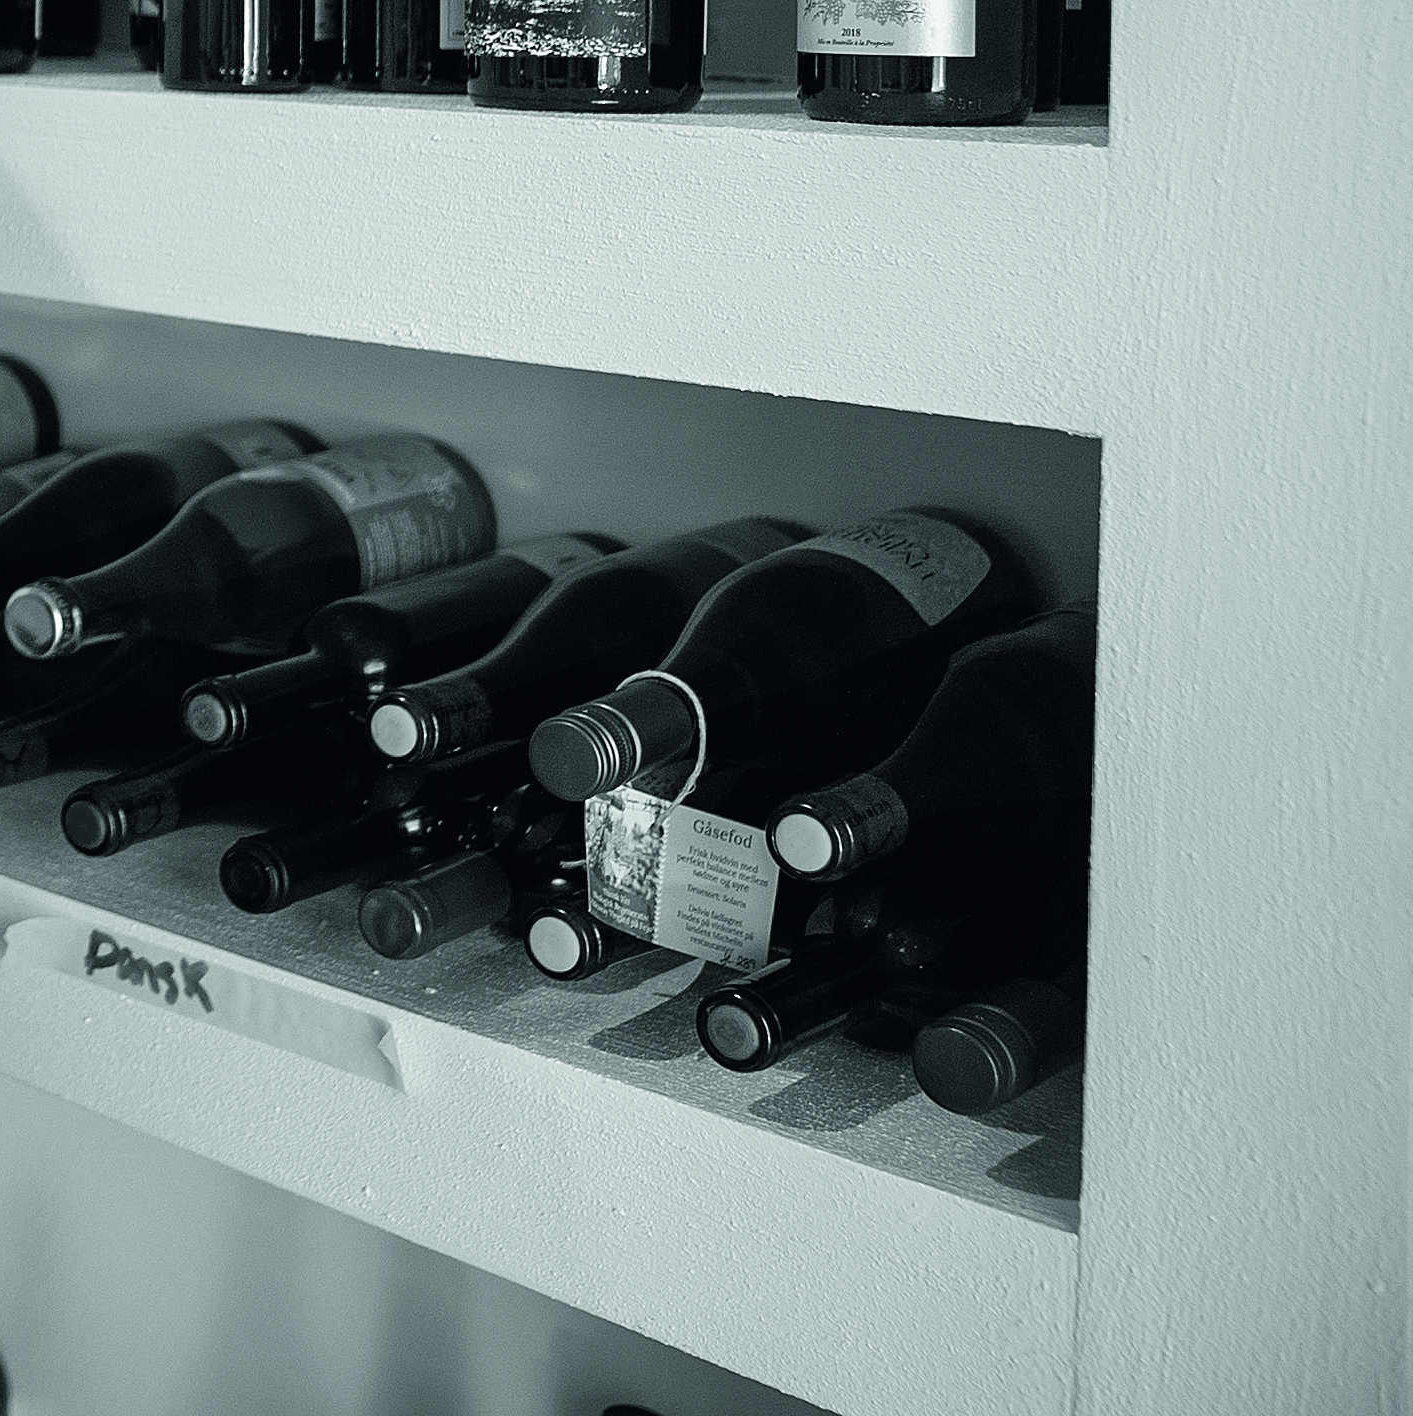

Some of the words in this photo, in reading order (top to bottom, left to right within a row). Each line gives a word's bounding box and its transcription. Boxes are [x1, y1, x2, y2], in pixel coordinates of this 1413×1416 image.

[841, 28, 861, 37] 2018
[693, 819, 753, 849] Gåsefod
[740, 864, 759, 874] med
[720, 878, 731, 889] og
